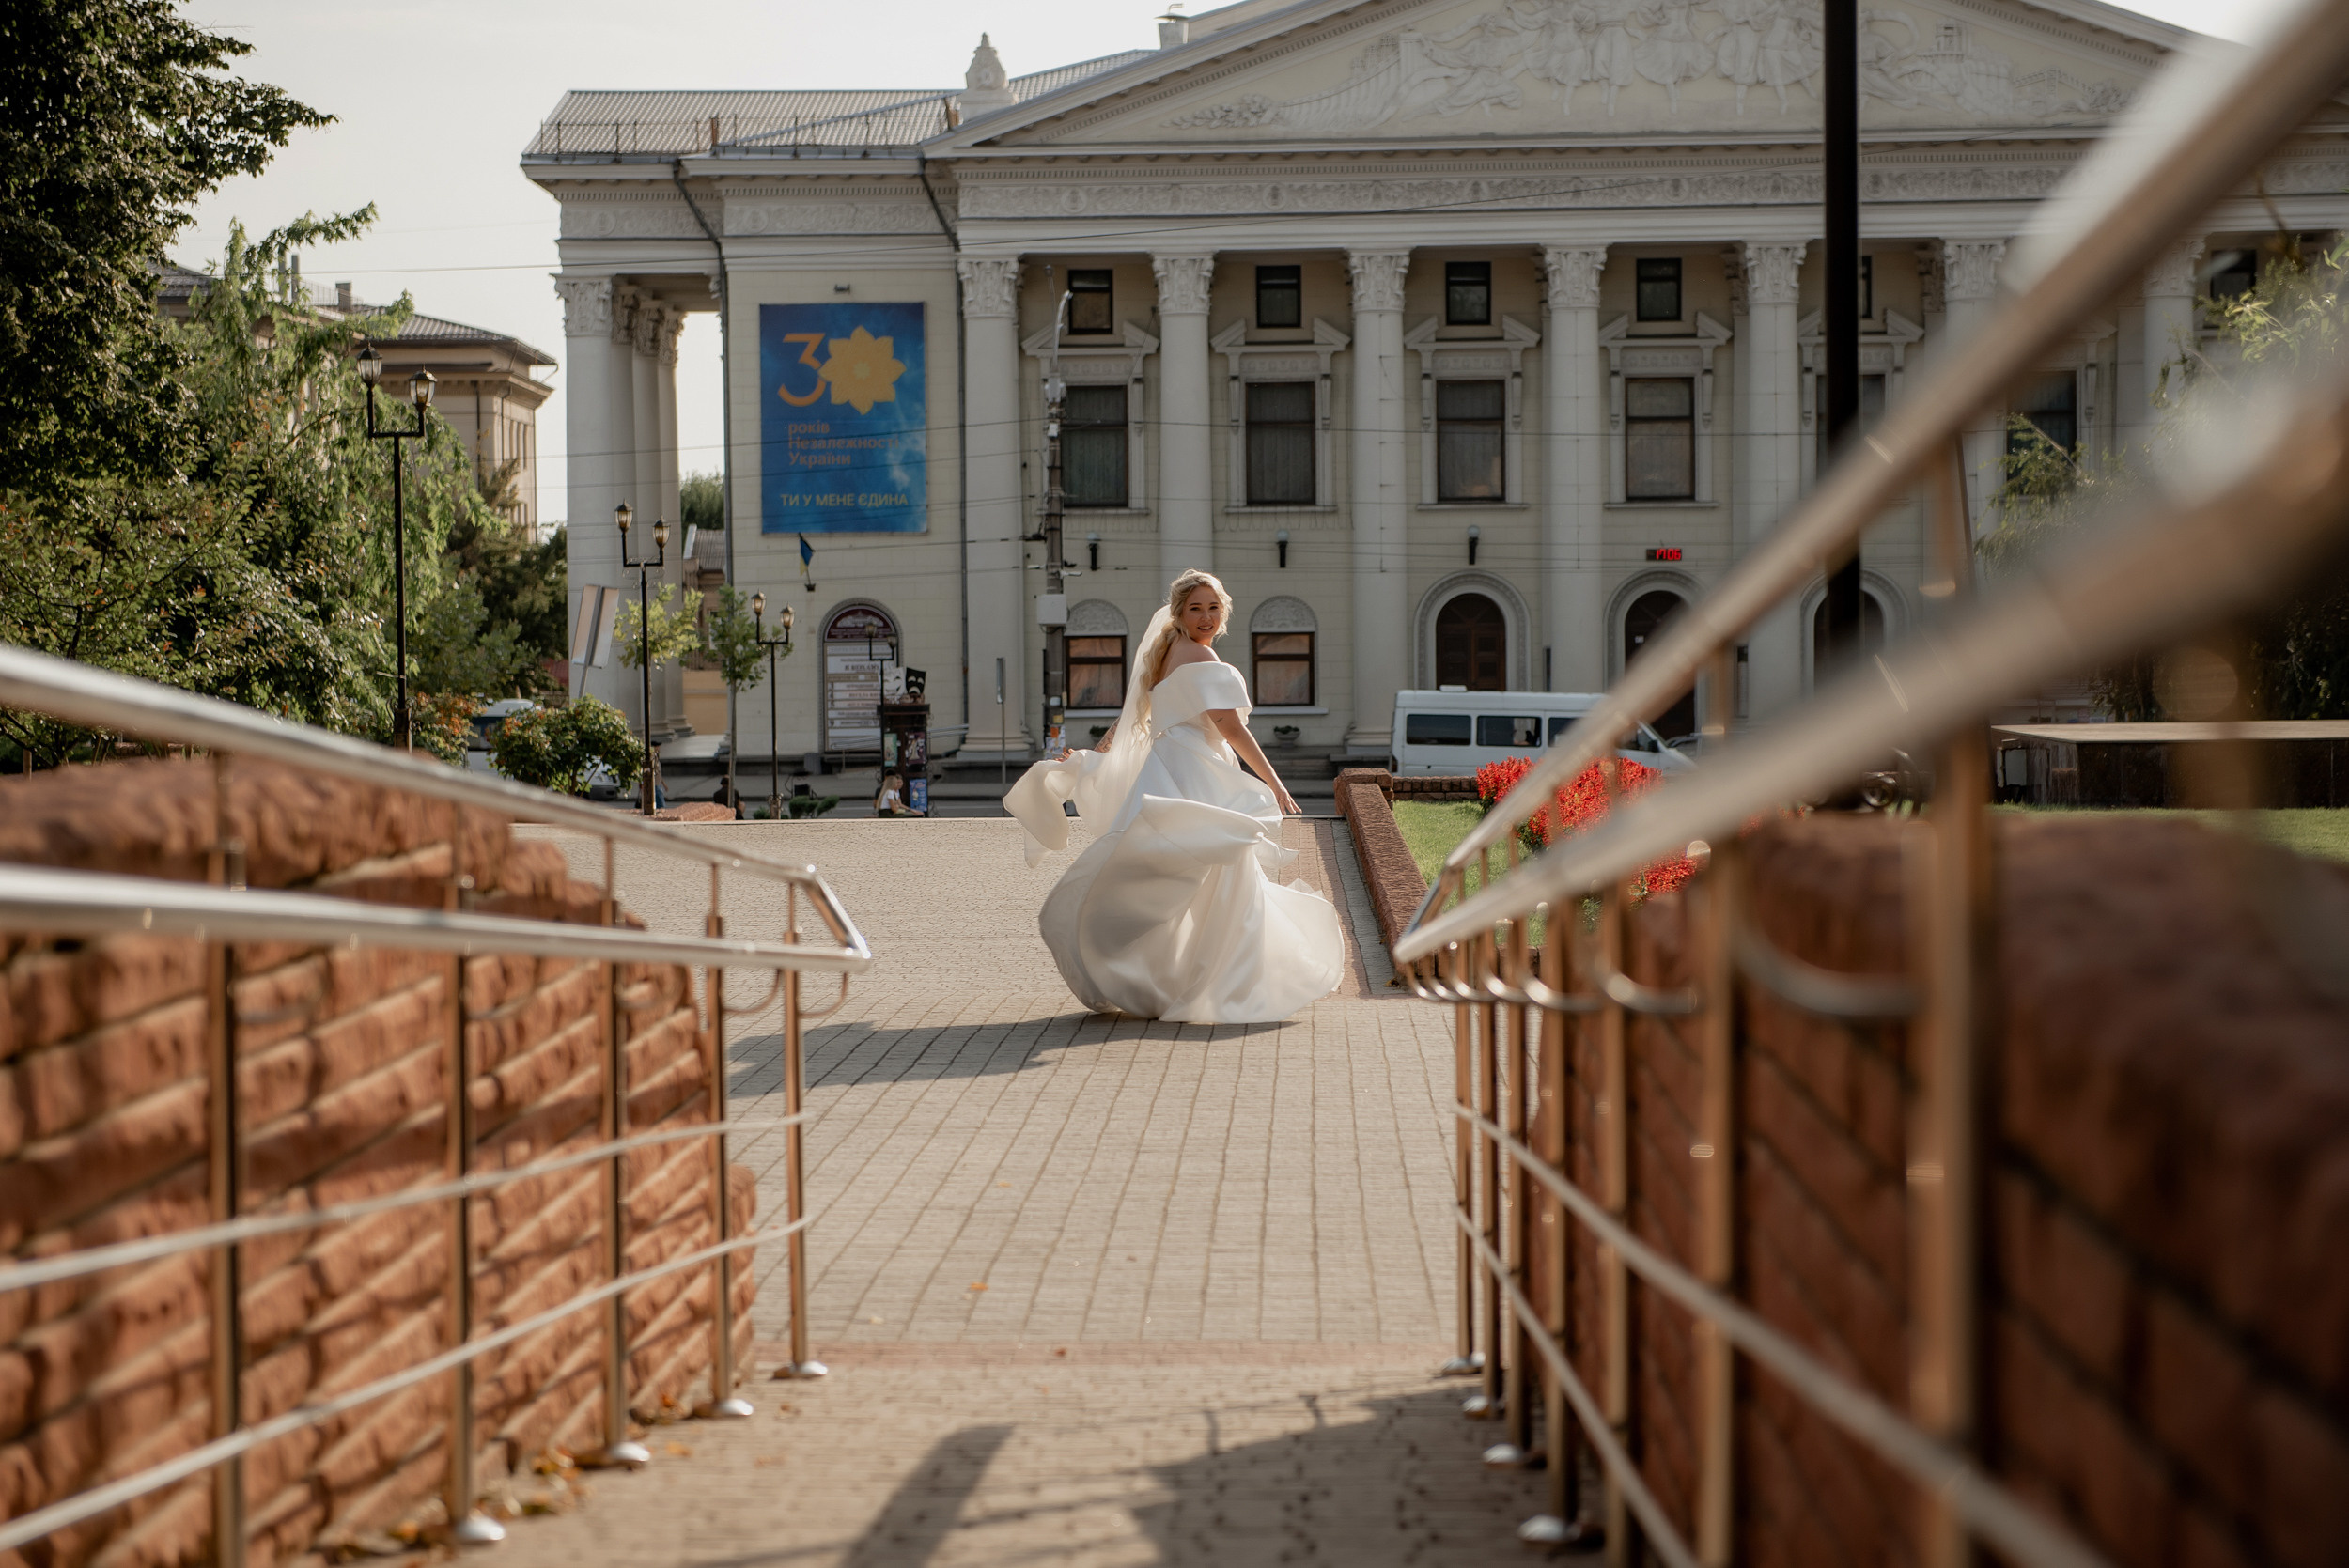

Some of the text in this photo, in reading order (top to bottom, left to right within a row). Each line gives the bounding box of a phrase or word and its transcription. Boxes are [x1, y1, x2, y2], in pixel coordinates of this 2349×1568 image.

[788, 420, 830, 435] років
[788, 434, 900, 450] Незалежності
[788, 451, 851, 469] України
[780, 493, 909, 507] ТИ У МЕНЕ ЄДИНА
